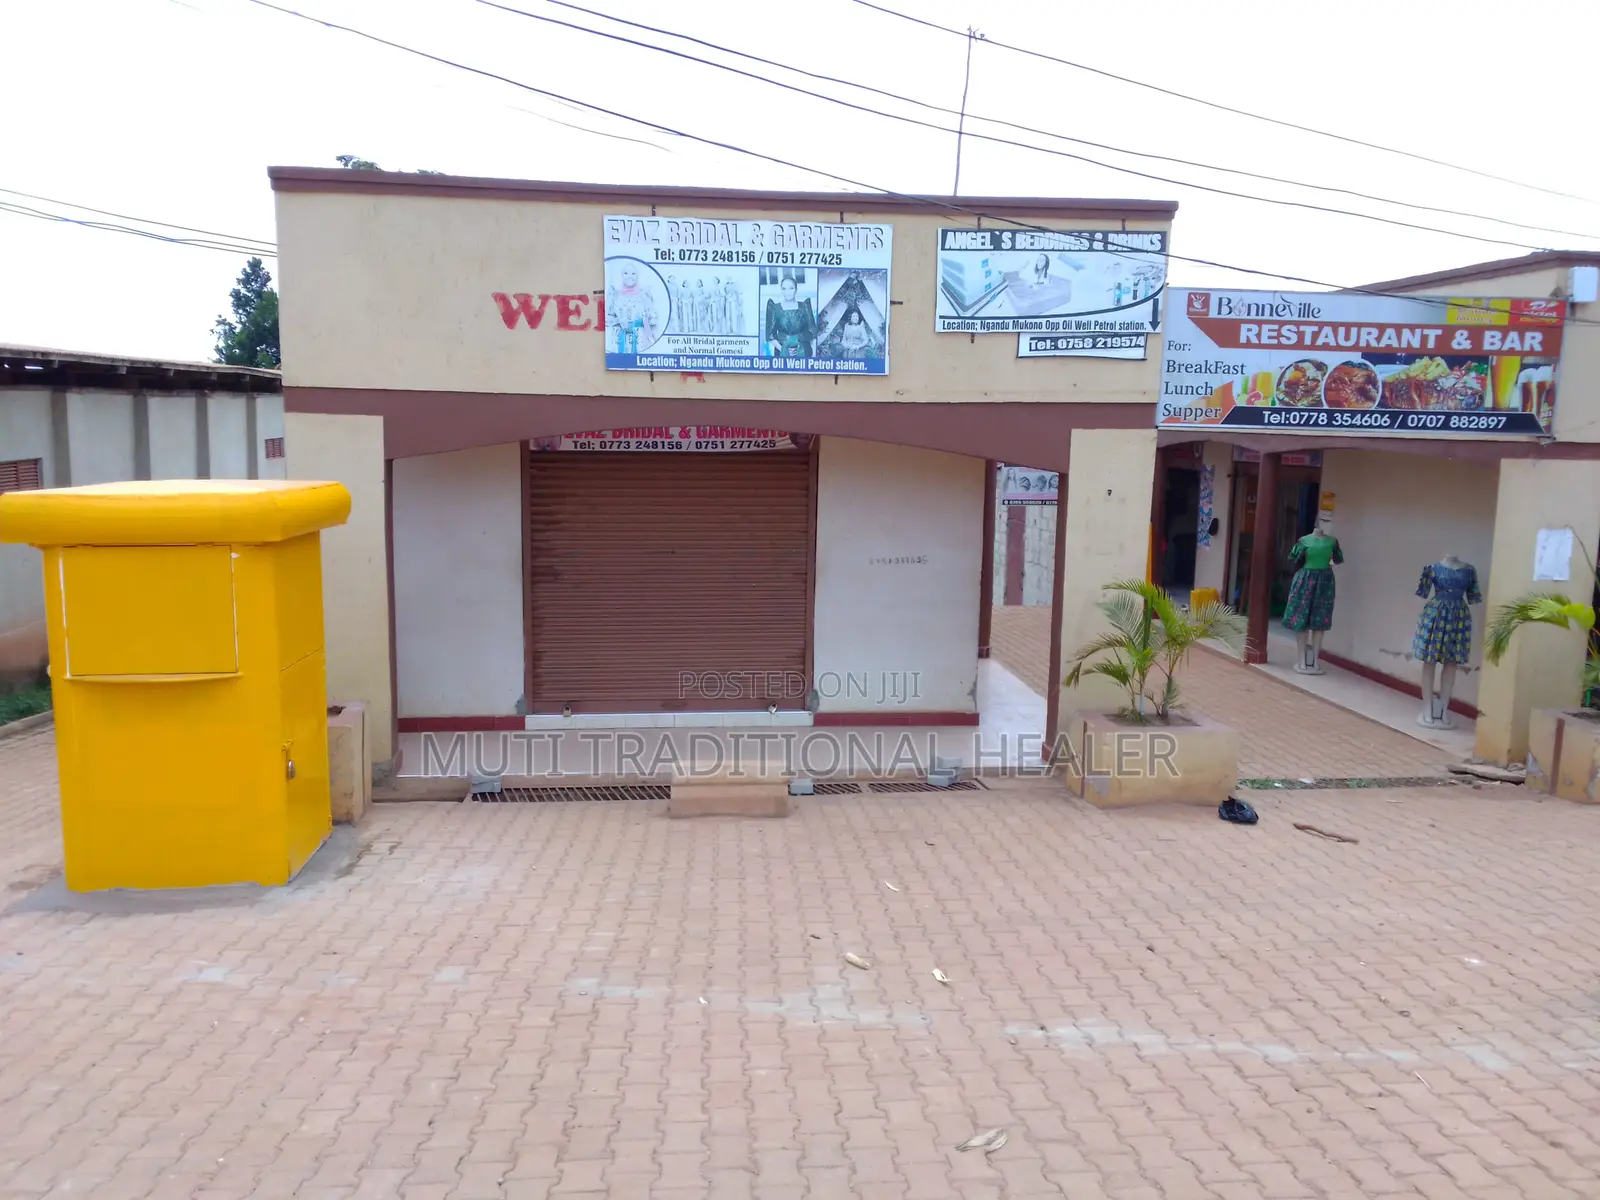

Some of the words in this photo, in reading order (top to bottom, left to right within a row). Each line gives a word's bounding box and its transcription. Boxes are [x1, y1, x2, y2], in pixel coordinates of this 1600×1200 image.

[607, 218, 660, 244] EVAZ
[666, 220, 743, 246] BRIDAL
[751, 223, 764, 247] &
[772, 224, 884, 250] GARMENTS
[1093, 232, 1105, 250] &
[1107, 233, 1162, 252] DRINKS
[653, 247, 675, 262] Tel;
[678, 248, 708, 262] 0773
[711, 249, 756, 263] 248156
[758, 251, 764, 264] /
[767, 251, 795, 264] 0751
[799, 252, 843, 265] 277425
[1217, 294, 1322, 318] Bonneville
[980, 320, 1010, 331] Ngandu
[1012, 319, 1043, 331] Mukono
[1045, 319, 1060, 331] Opp
[1062, 319, 1073, 331] Oil
[1075, 320, 1092, 331] Well
[1094, 320, 1117, 331] Petrol
[1119, 319, 1147, 331] station.
[667, 336, 680, 345] For
[681, 337, 692, 345] All
[693, 337, 715, 346] Bridal
[716, 338, 750, 347] garments
[1029, 338, 1055, 351] Tel:
[1057, 337, 1093, 349] 0758
[1096, 335, 1145, 348] 219574
[1239, 322, 1443, 350] RESTAURANT
[1451, 329, 1473, 350] &
[1483, 330, 1544, 352] BAR
[1167, 340, 1192, 352] For:
[680, 356, 714, 369] Ngandu
[716, 357, 751, 368] Mukono
[753, 357, 770, 370] Opp
[772, 358, 784, 369] Oil
[786, 358, 806, 369] Well
[808, 359, 834, 370] Petrol
[836, 360, 868, 370] station.
[1165, 359, 1246, 375] BreakFast
[1164, 381, 1214, 396] Lunch
[1162, 403, 1221, 421] Supper
[1332, 412, 1391, 427] 354606
[1393, 414, 1403, 429] /
[1407, 414, 1446, 427] 0707
[1450, 415, 1507, 429] 882897
[600, 440, 631, 450] 0773
[636, 440, 683, 450] 248156
[686, 440, 692, 450] /
[695, 440, 725, 449] 0751
[730, 439, 776, 449] 277425
